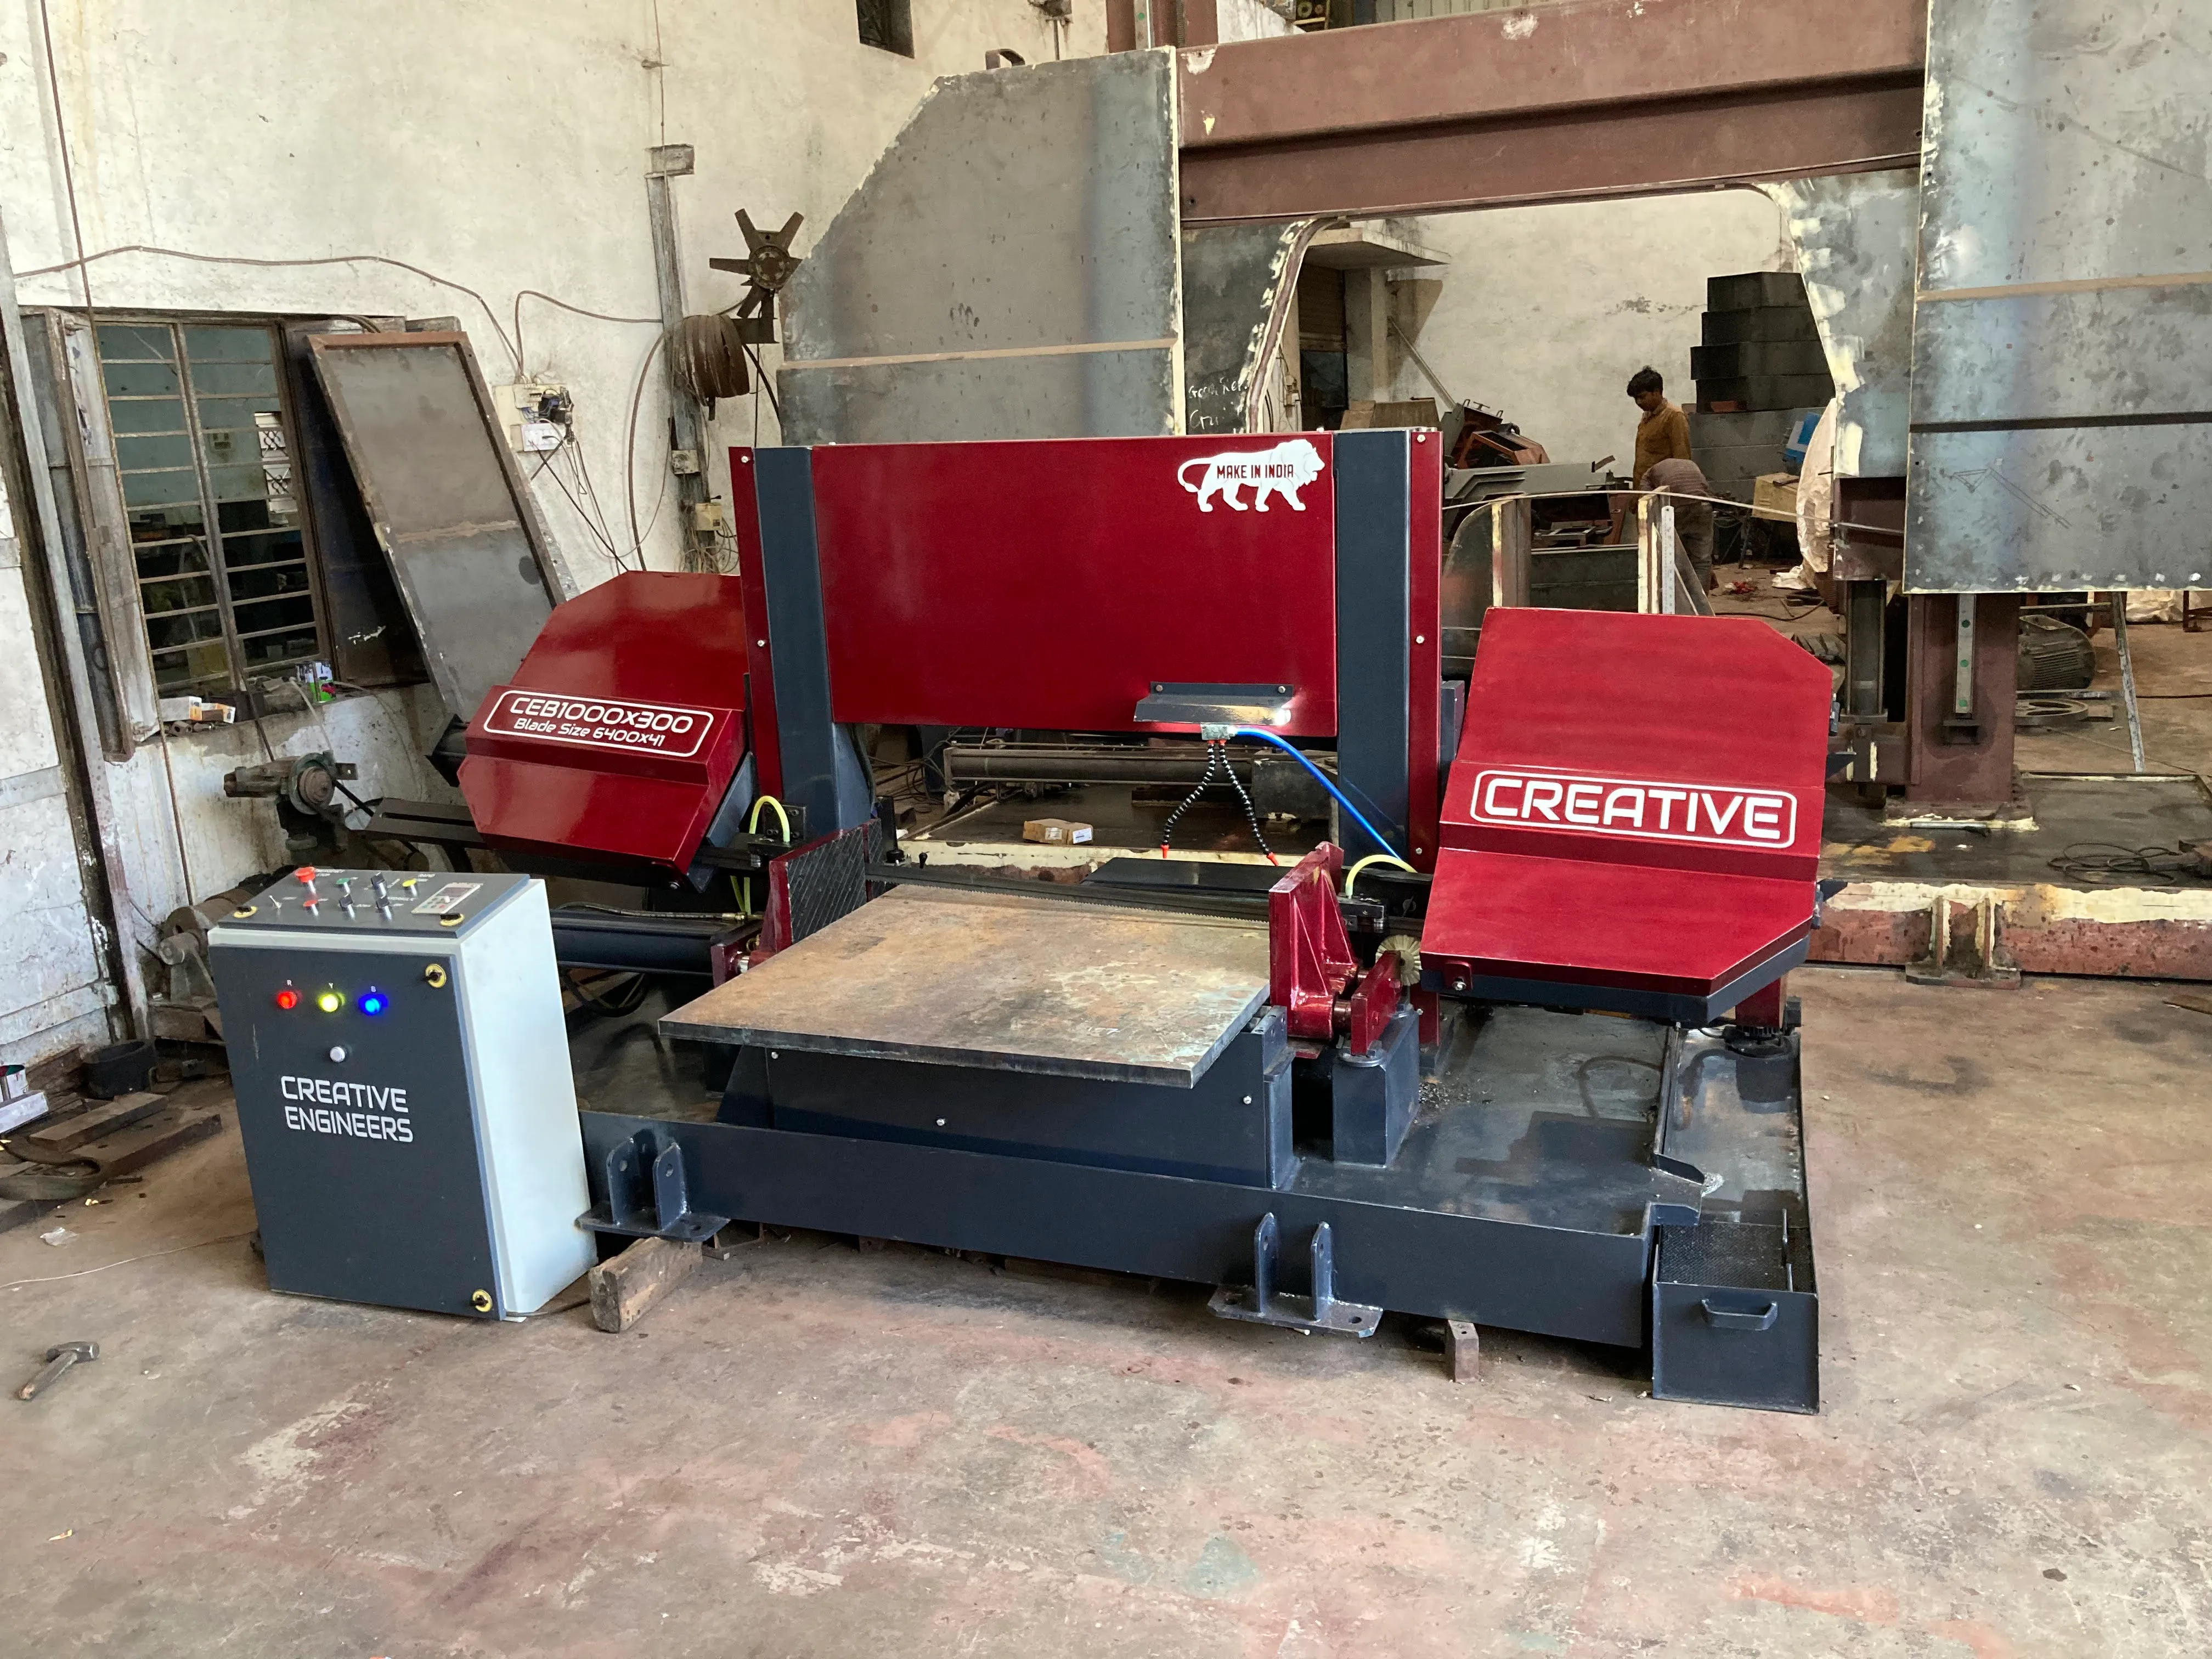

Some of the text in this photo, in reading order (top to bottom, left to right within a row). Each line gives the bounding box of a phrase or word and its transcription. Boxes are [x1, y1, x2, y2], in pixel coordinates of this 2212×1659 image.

[1217, 464, 1294, 479] MAKE IN INDIA
[513, 718, 557, 733] Blade
[557, 722, 591, 737] Size
[1484, 778, 1783, 840] CREATIVE
[280, 1075, 409, 1113] CREATIVE
[284, 1105, 414, 1143] ENGINEERS
